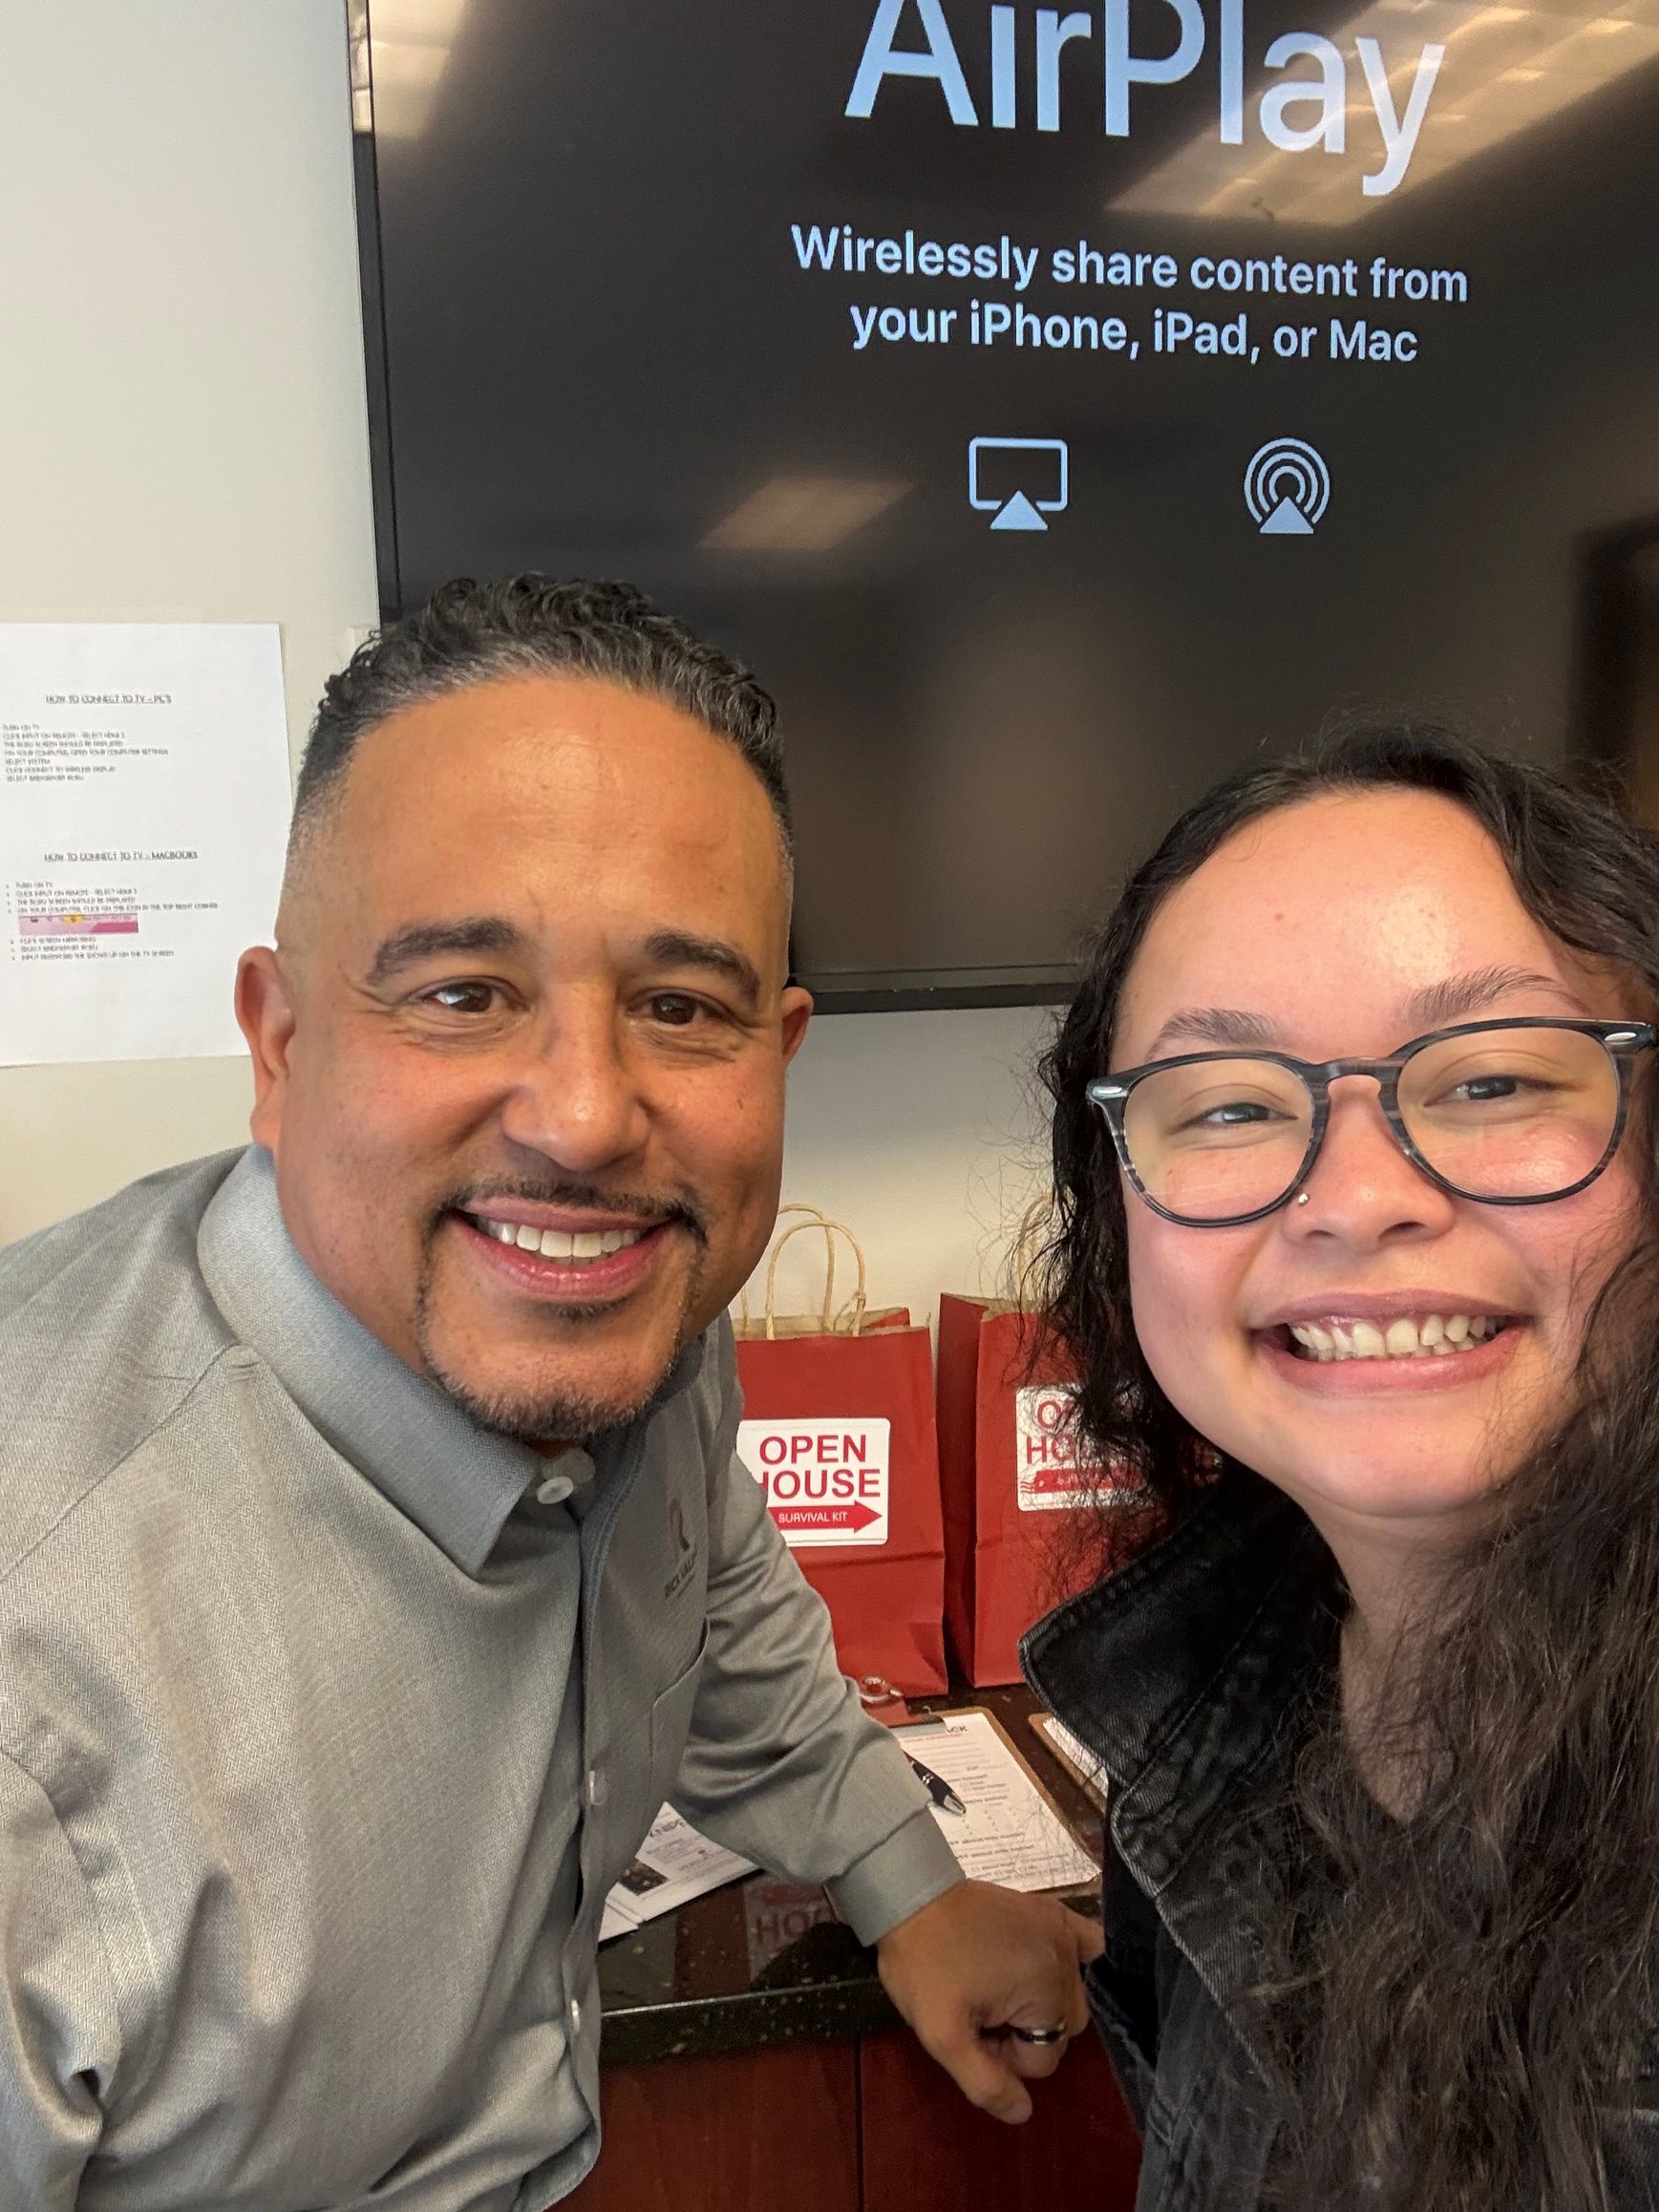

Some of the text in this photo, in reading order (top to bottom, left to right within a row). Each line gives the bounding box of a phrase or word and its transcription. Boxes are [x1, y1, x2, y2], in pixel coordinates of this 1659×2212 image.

[844, 0, 1445, 196] AirPlay
[791, 223, 1468, 302] Wirelessly share content from
[850, 299, 1418, 364] your iPhone, iPad, or Mac
[759, 1435, 866, 1465] OPEN
[778, 1511, 848, 1523] SURVIVAL KIT
